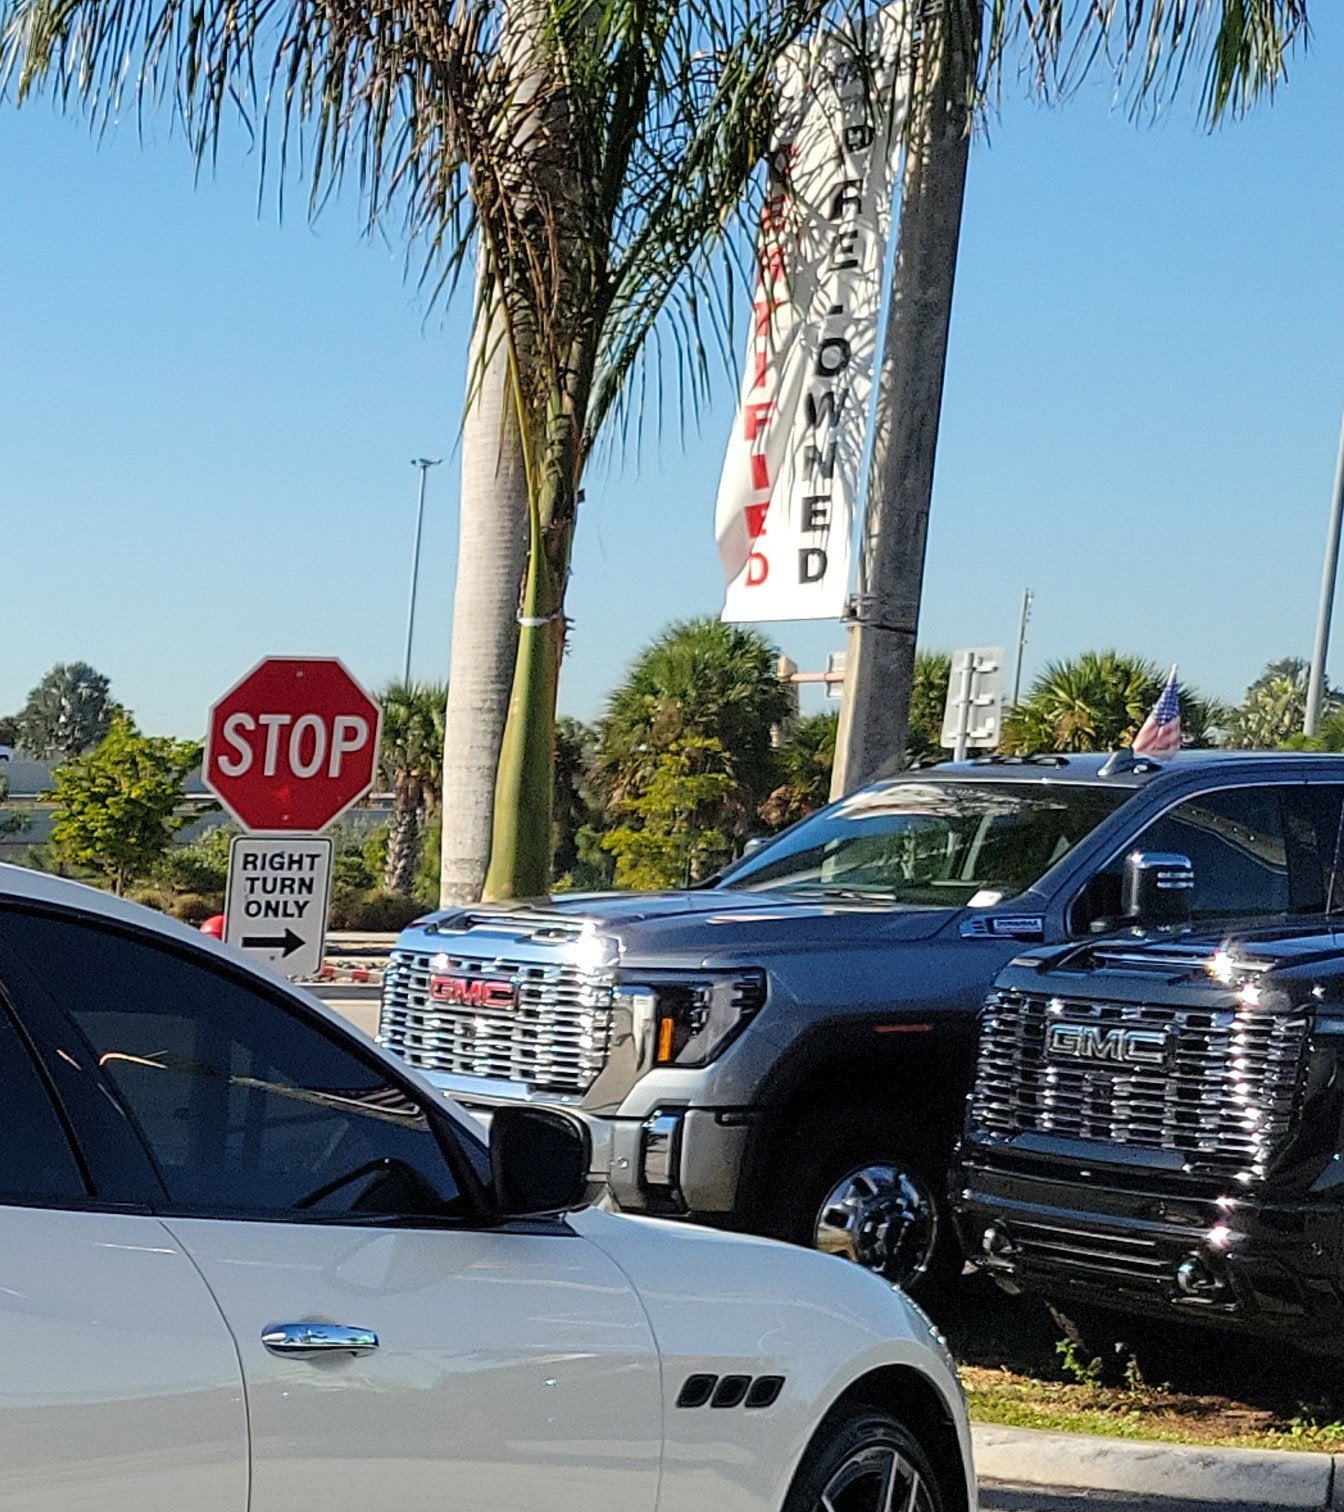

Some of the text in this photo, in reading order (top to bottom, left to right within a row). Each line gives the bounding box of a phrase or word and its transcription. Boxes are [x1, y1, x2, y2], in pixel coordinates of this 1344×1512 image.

[217, 712, 370, 779] STOP
[241, 851, 322, 872] RIGHT
[244, 876, 315, 895] TURN
[244, 900, 311, 919] ONLY
[430, 974, 516, 1011] GMC
[1048, 1022, 1169, 1065] GMC
